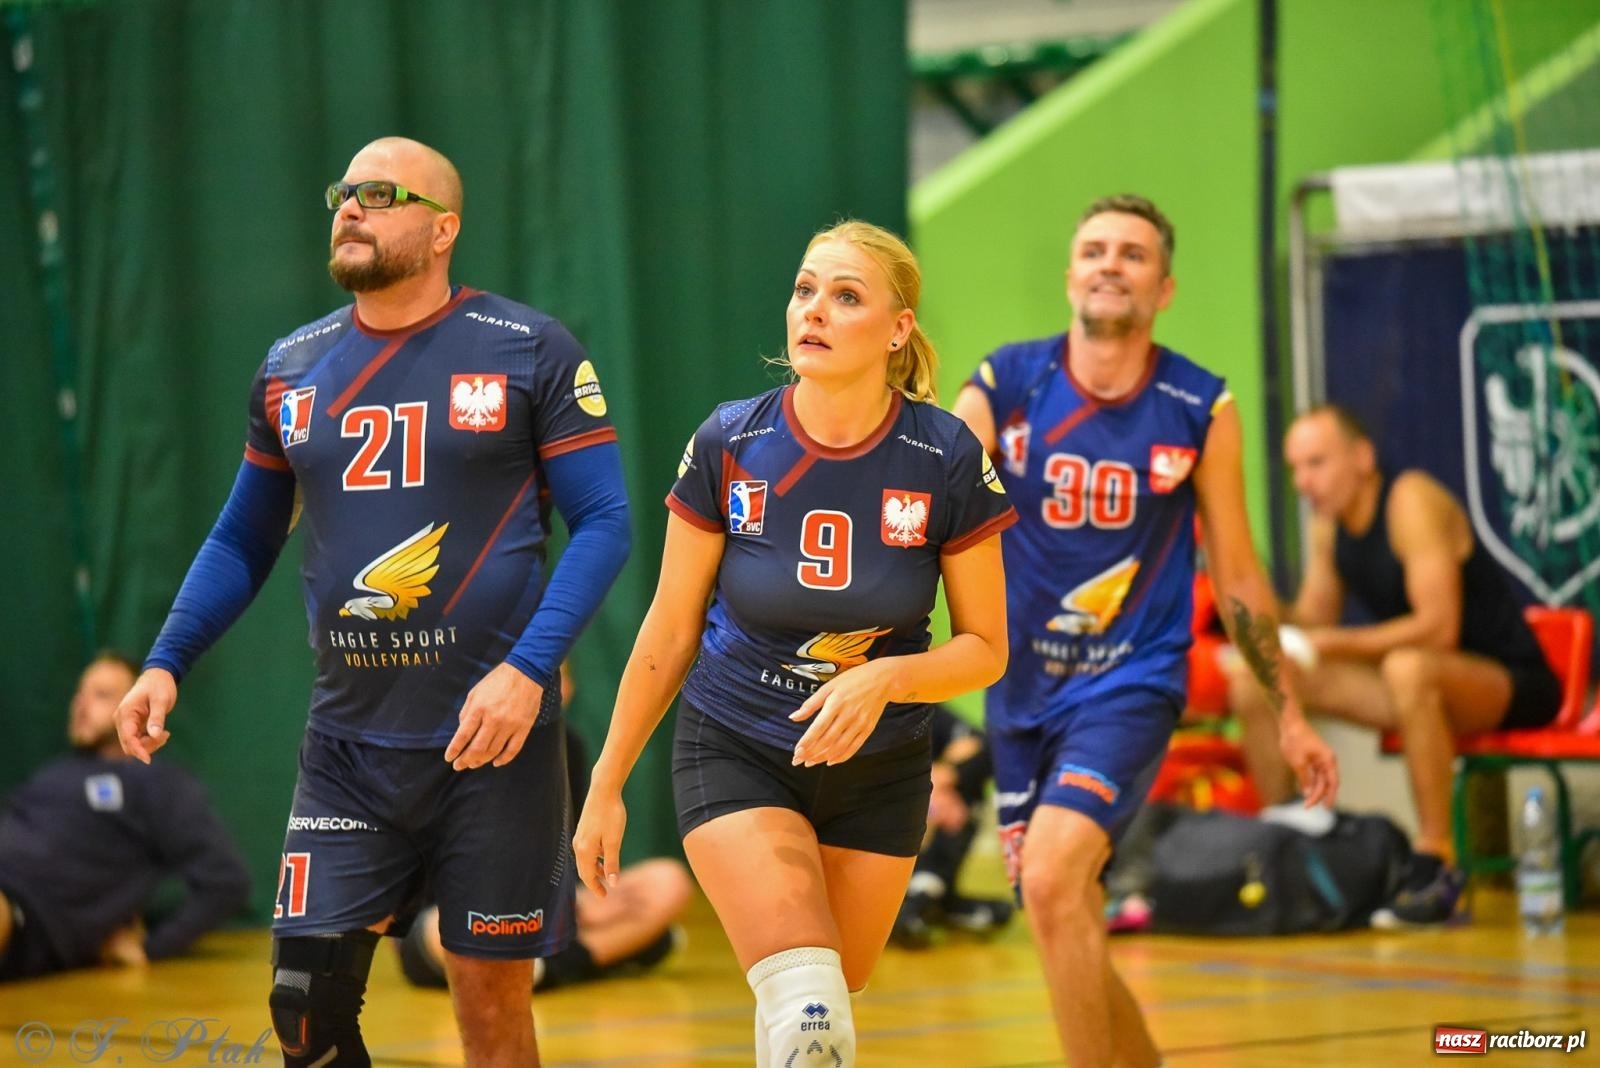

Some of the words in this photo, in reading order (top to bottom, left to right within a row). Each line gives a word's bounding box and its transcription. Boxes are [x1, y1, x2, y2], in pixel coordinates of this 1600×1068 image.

[465, 311, 531, 335] AURATOR
[340, 401, 428, 491] 21
[898, 434, 944, 456] AURATOR
[1042, 452, 1138, 530] 30
[746, 522, 761, 532] BVC
[797, 509, 853, 591] 9
[329, 630, 379, 649] EAGLE
[391, 626, 457, 648] SPORT
[760, 669, 818, 694] EAGLE
[800, 1020, 831, 1032] errea
